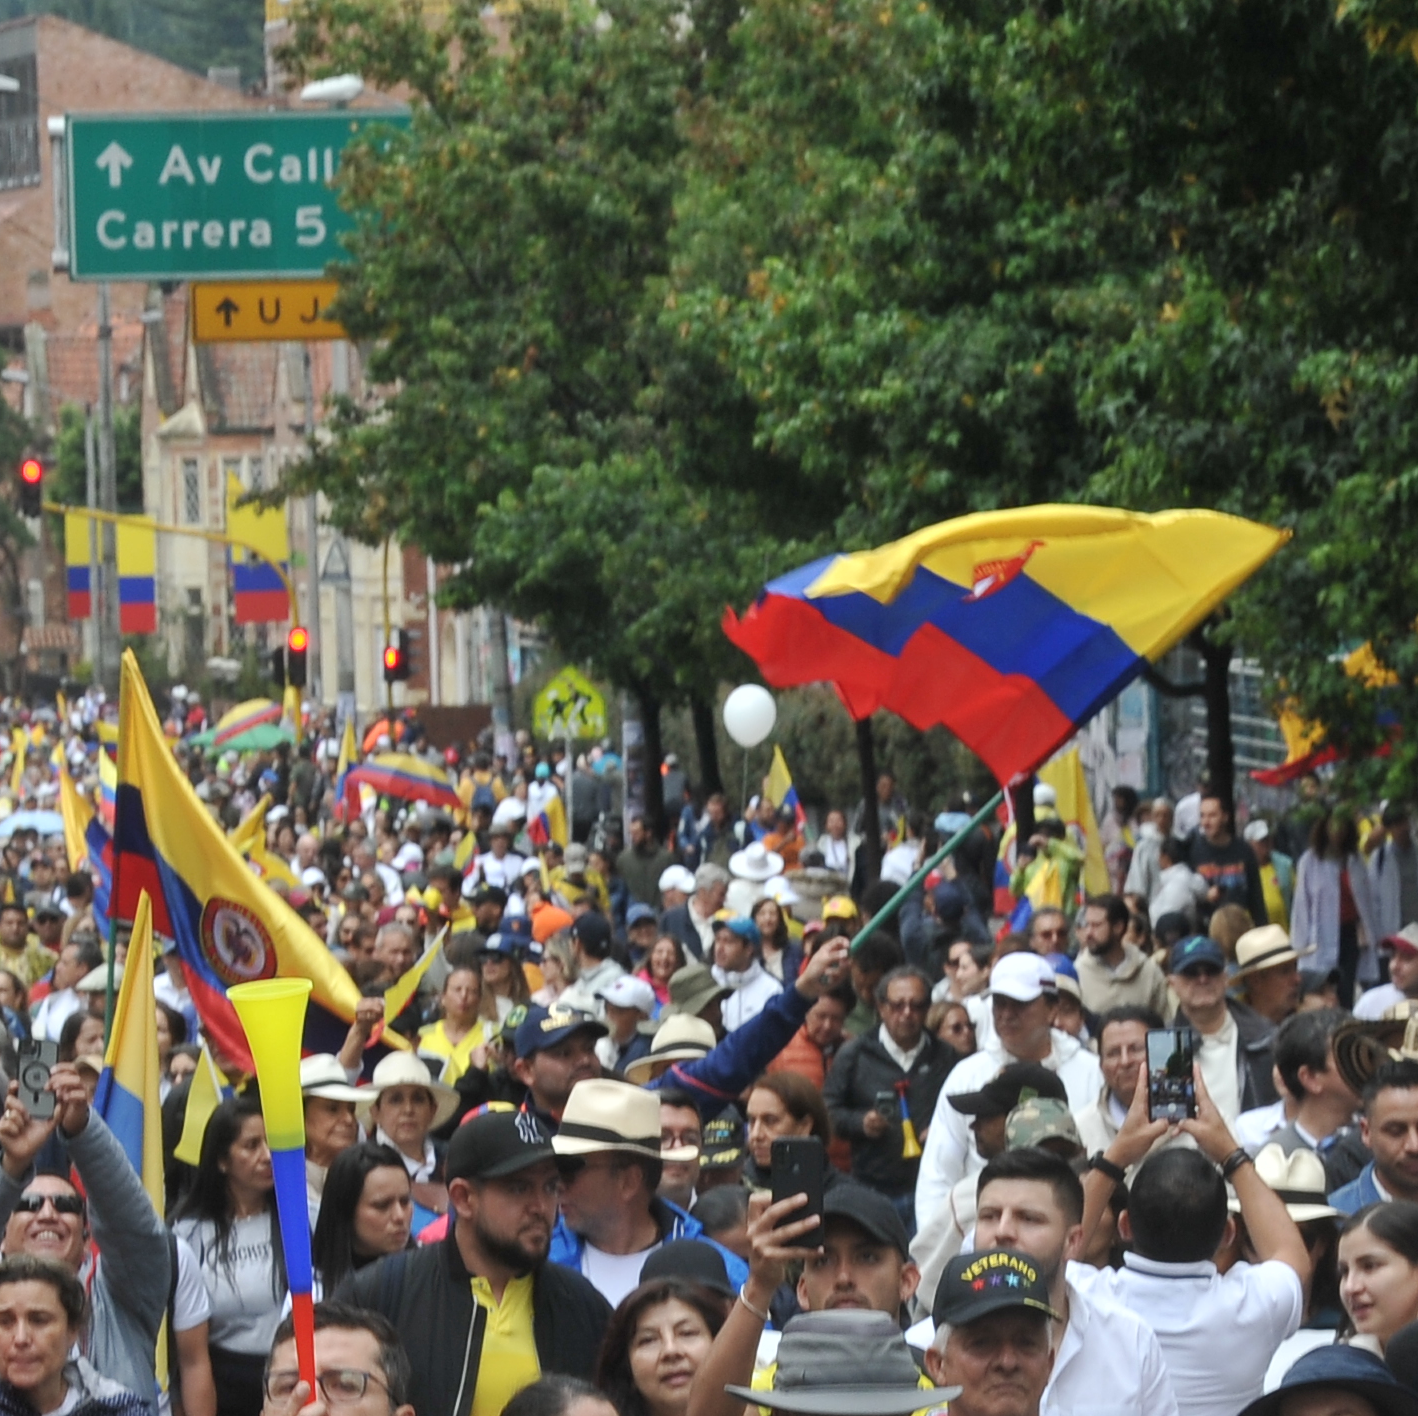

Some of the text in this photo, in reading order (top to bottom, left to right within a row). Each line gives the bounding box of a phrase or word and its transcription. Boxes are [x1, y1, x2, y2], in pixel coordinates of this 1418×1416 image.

[159, 143, 222, 185] Av
[96, 205, 327, 250] Carrera 5
[258, 297, 281, 324] U
[961, 1252, 1037, 1283] VETERANO
